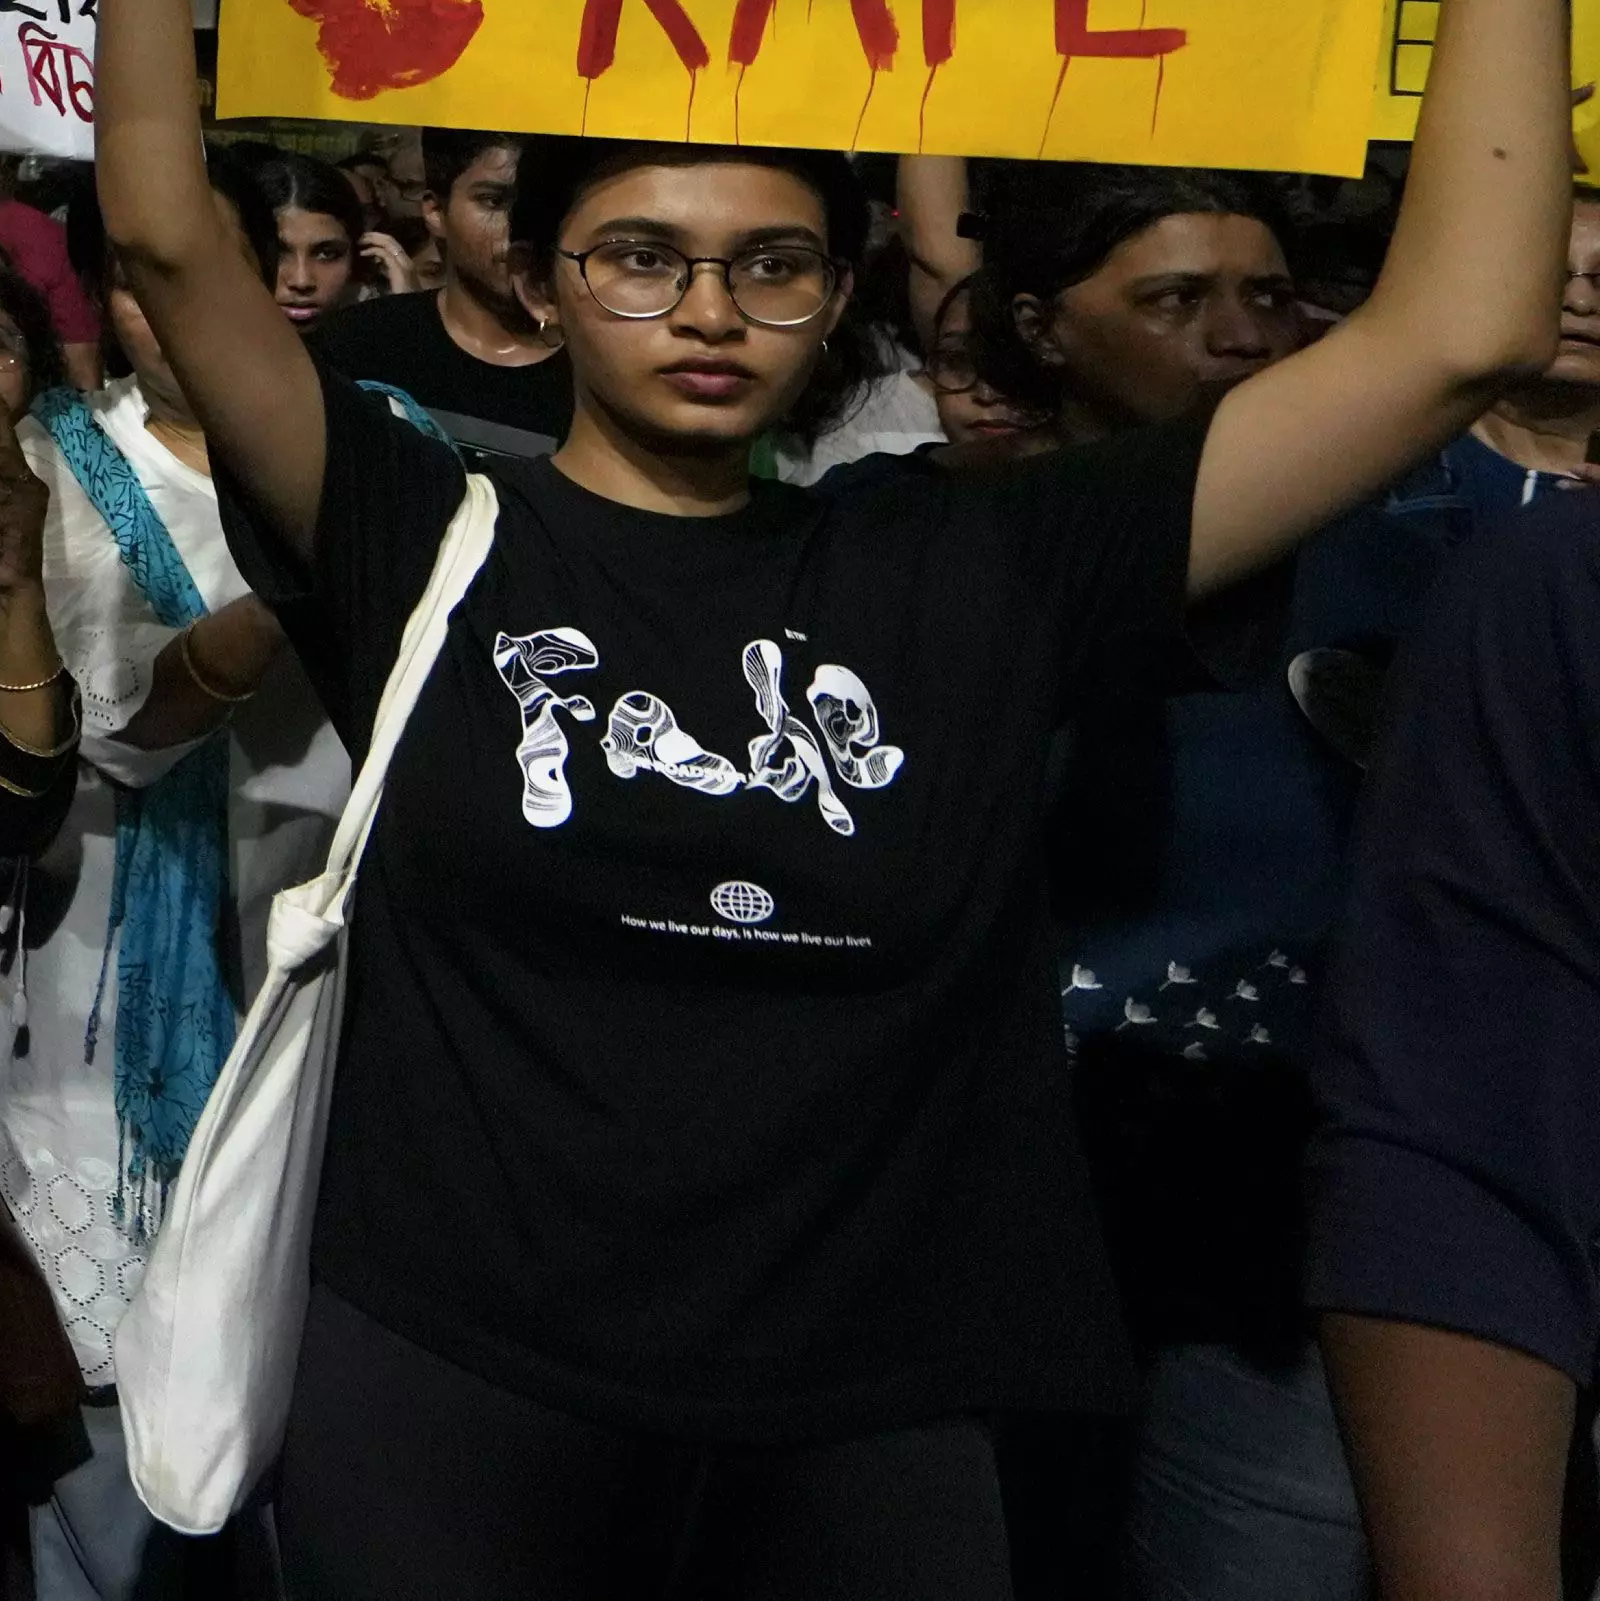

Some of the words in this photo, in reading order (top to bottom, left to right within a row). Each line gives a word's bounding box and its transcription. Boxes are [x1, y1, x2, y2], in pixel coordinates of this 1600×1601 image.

[620, 913, 647, 929] How
[648, 920, 666, 932] we
[668, 919, 688, 934] live
[690, 925, 710, 937] our
[754, 928, 780, 942] how
[781, 931, 799, 943] we
[801, 931, 822, 946] live
[824, 935, 844, 947] our
